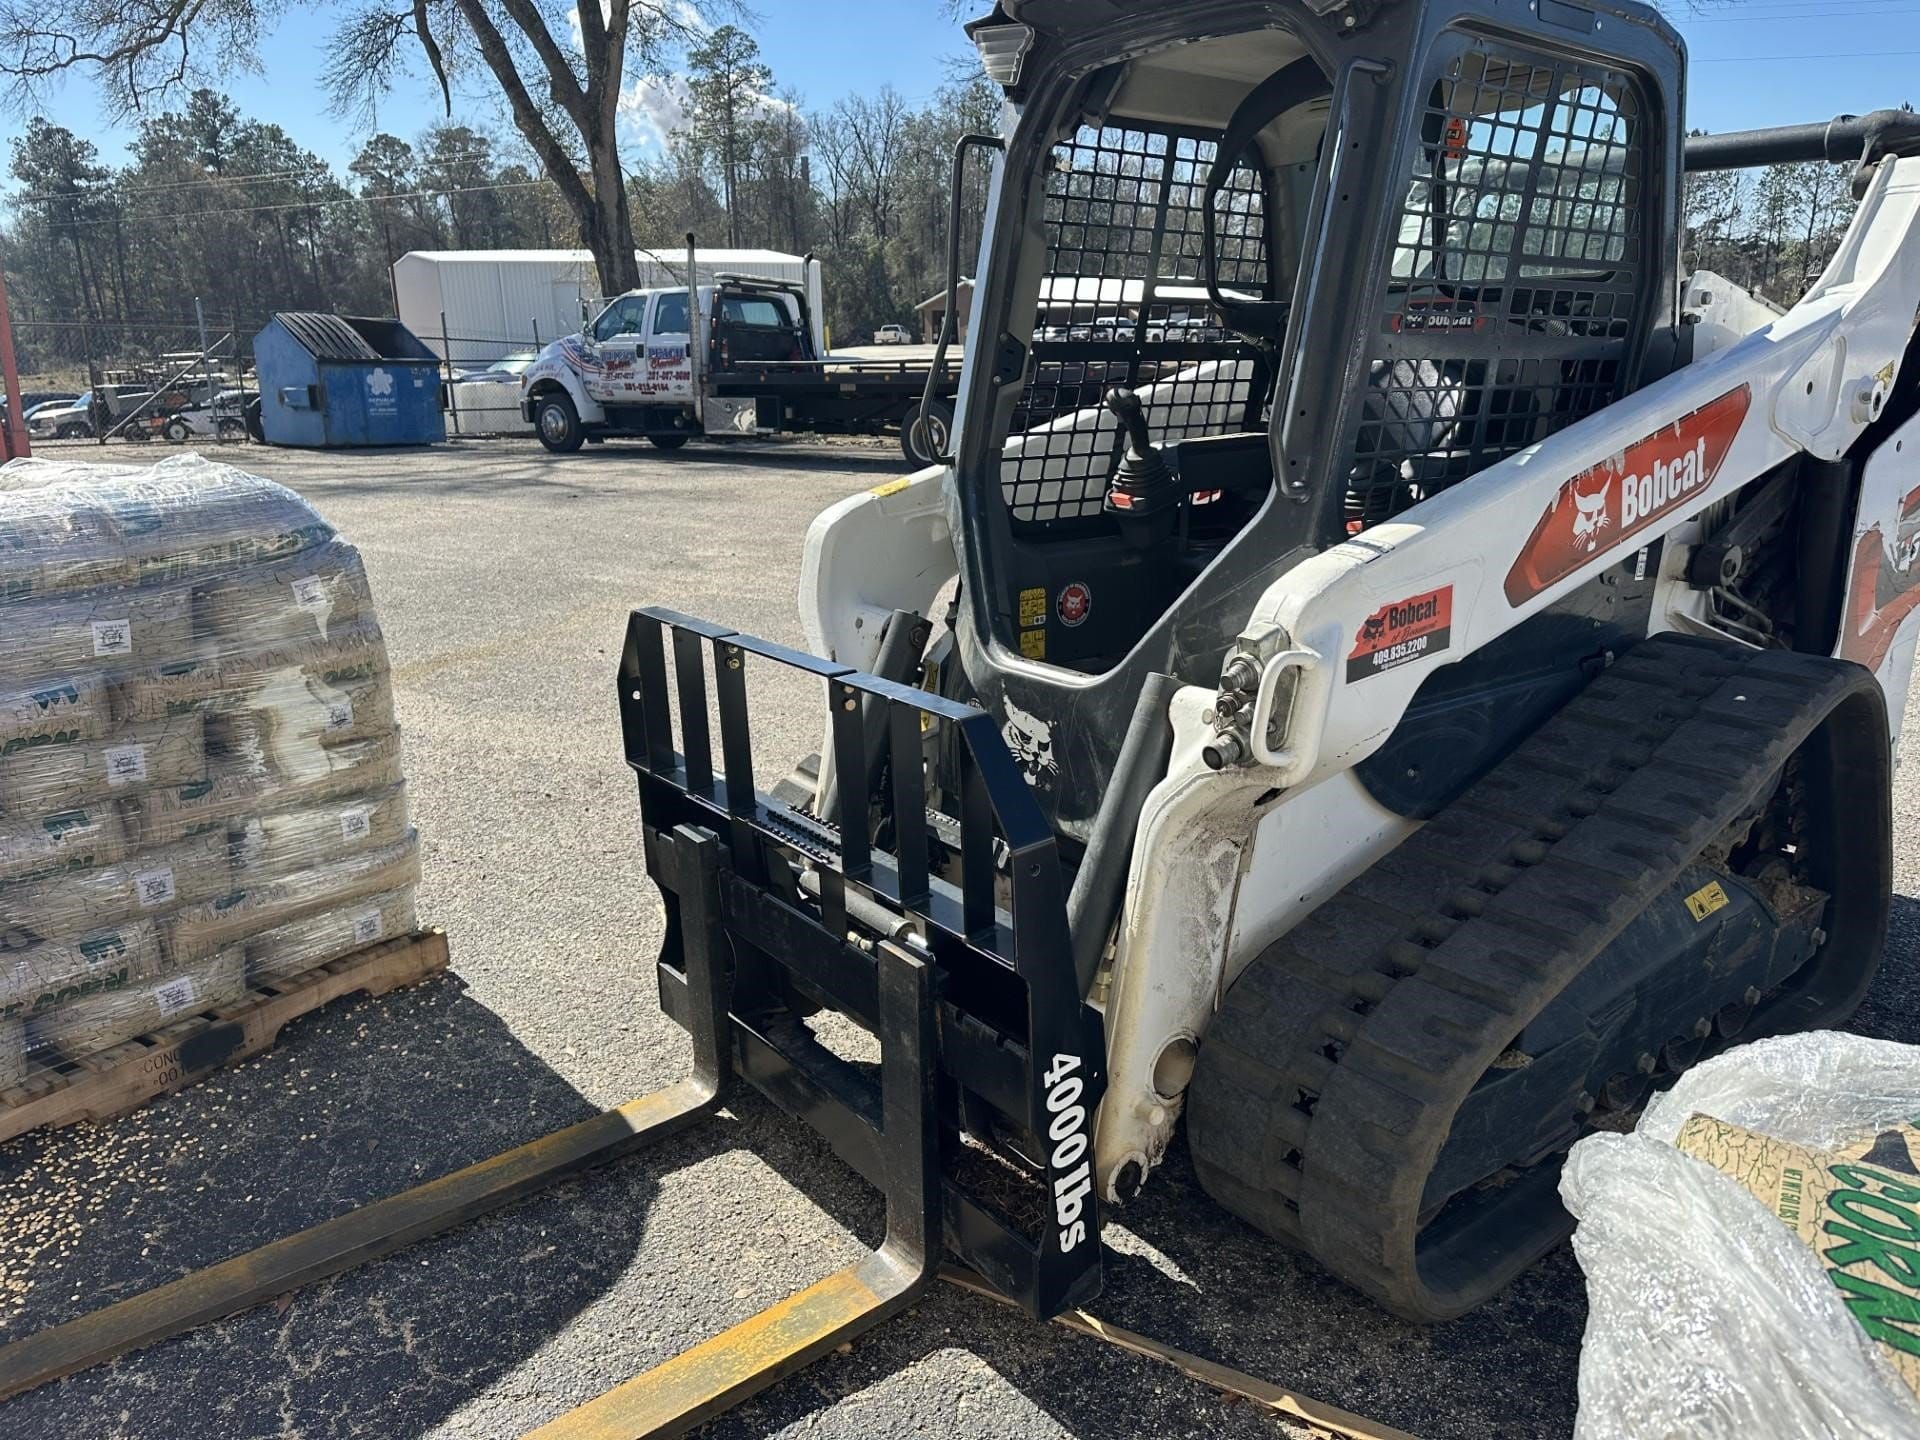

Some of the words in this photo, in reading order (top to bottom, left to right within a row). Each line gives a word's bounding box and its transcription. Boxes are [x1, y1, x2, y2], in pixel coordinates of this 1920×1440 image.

[1622, 436, 1706, 529] Bobcat
[1372, 635, 1427, 666] 409.835.2200
[1388, 595, 1437, 631] Bobcat
[1043, 1053, 1088, 1169] 4000
[1054, 1160, 1091, 1253] lbs
[1823, 1164, 1920, 1357] CORN
